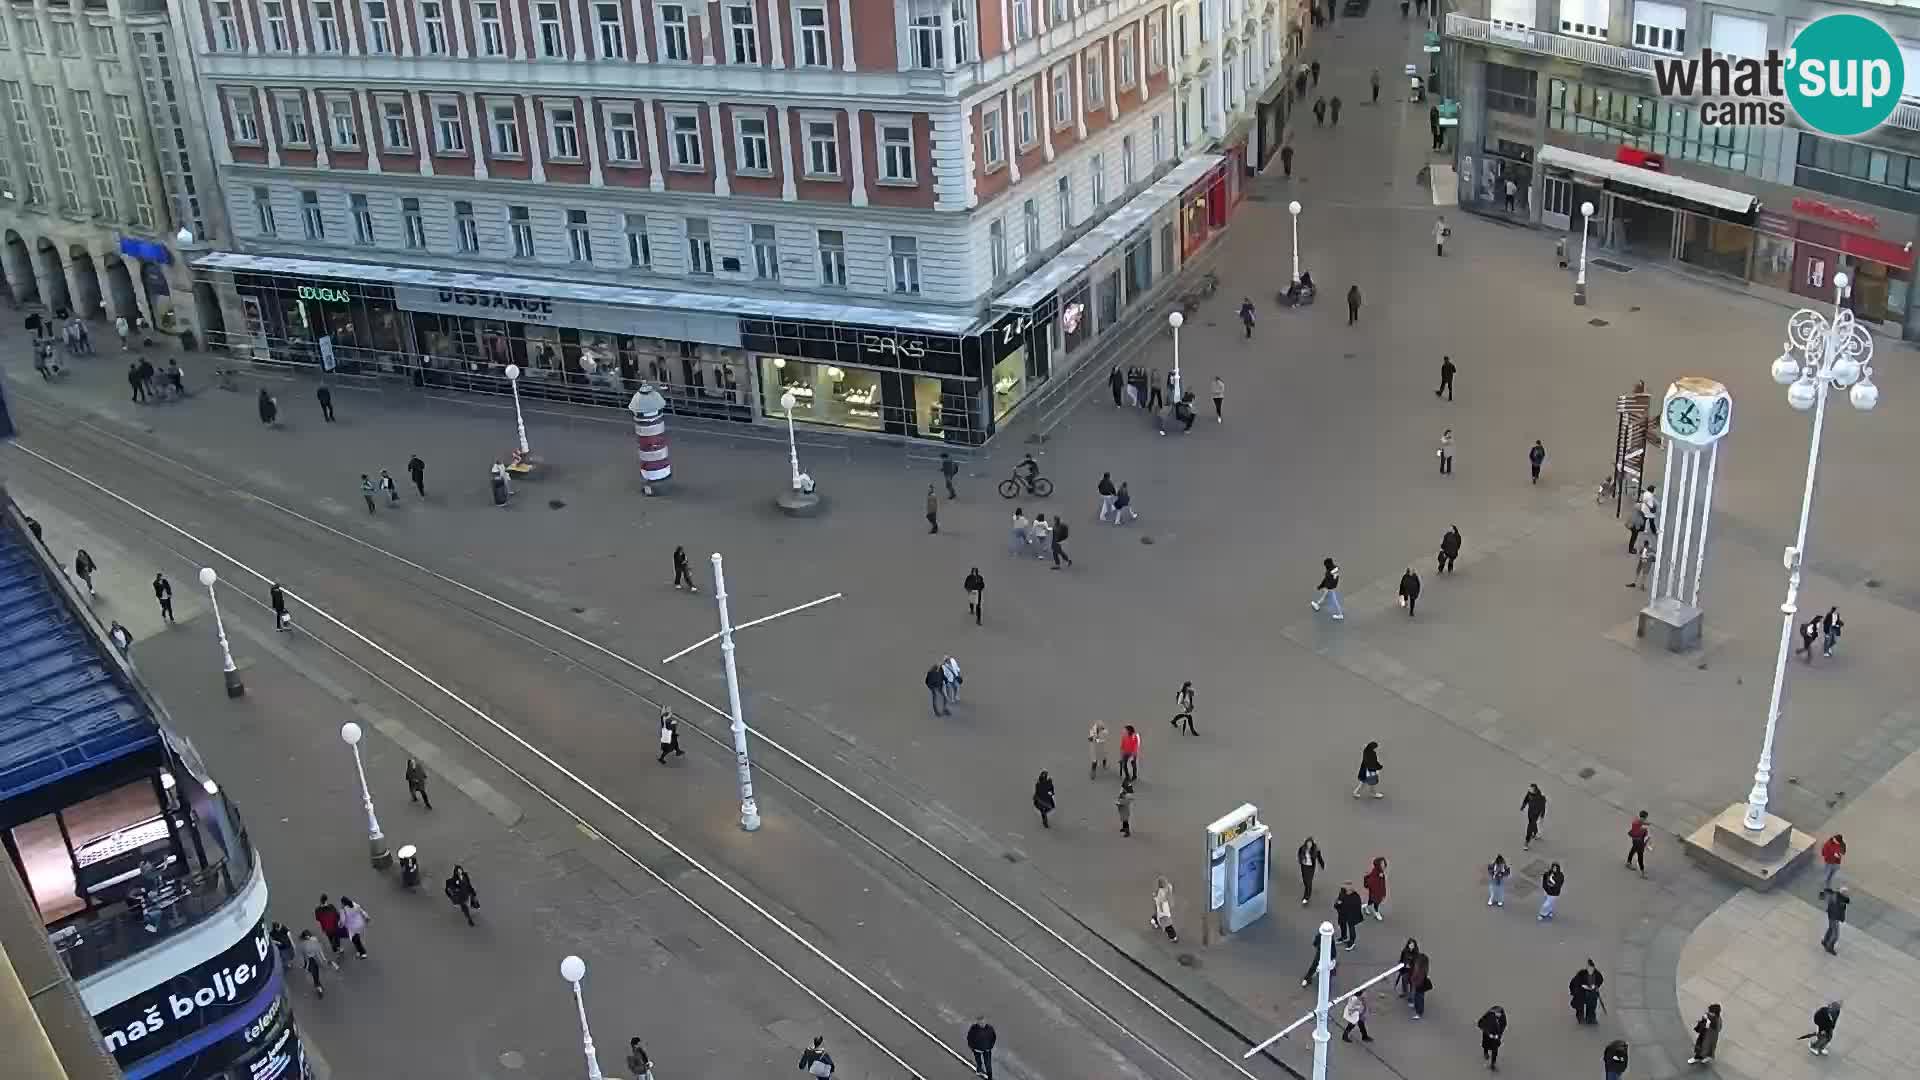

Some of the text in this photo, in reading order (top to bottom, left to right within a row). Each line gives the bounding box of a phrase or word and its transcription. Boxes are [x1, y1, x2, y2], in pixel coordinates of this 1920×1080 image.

[297, 286, 350, 303] DOUGLAS
[104, 1004, 164, 1053] naš
[168, 963, 257, 1020] bolje,
